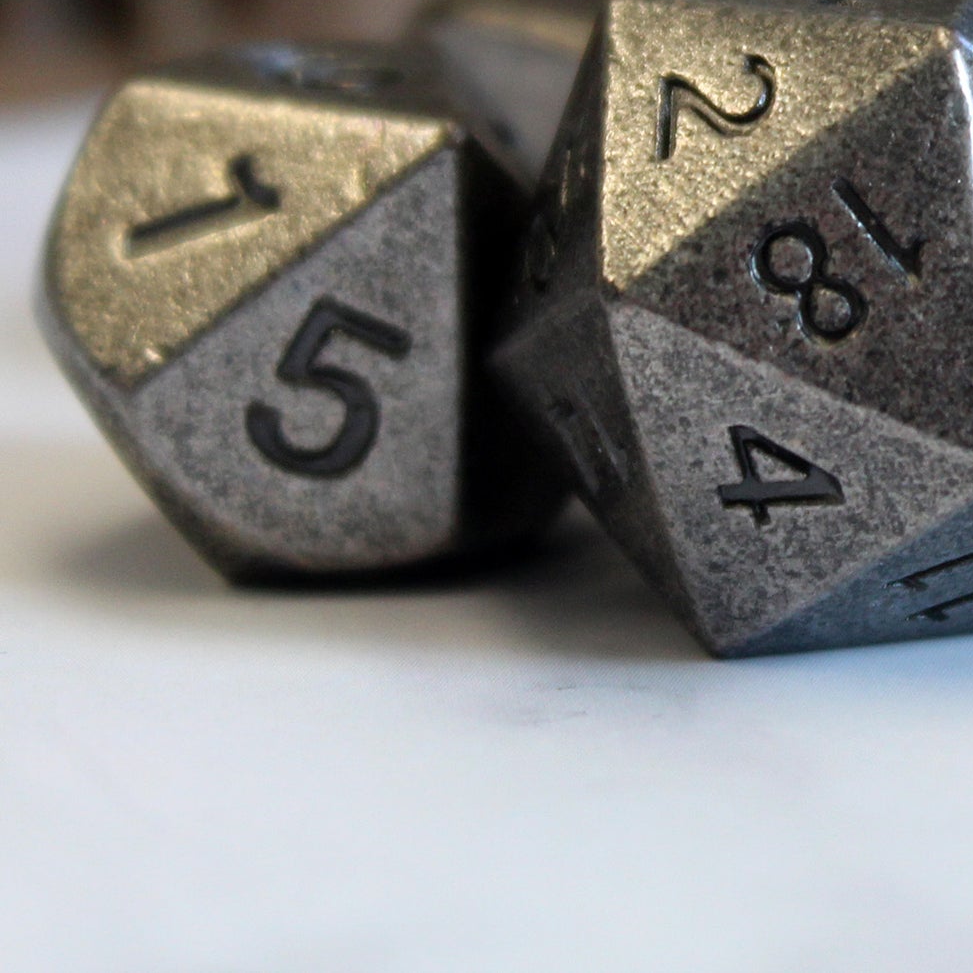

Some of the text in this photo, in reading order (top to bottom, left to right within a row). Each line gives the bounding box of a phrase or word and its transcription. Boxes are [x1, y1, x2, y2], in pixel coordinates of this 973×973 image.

[655, 54, 778, 161] 2
[124, 152, 282, 258] 1
[750, 177, 930, 345] 18
[244, 294, 412, 481] 5
[717, 424, 846, 527] 4
